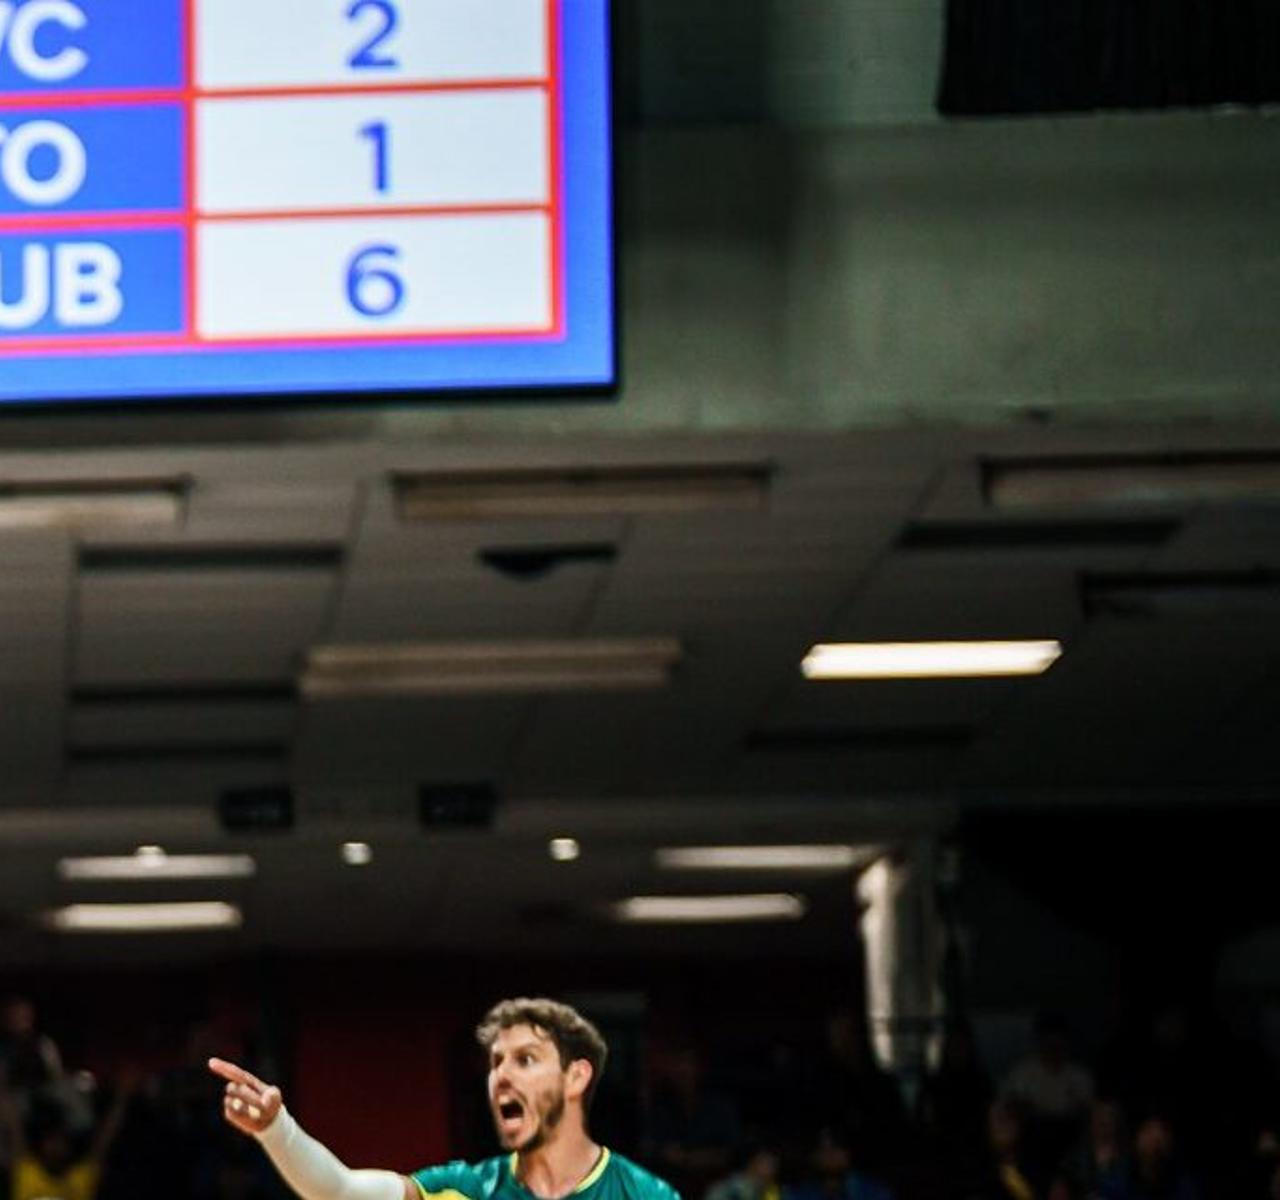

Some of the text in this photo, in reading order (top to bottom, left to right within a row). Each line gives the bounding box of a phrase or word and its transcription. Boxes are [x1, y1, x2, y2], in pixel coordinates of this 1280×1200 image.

[345, 0, 401, 69] 2
[356, 121, 390, 193] 1
[344, 244, 406, 317] 6
